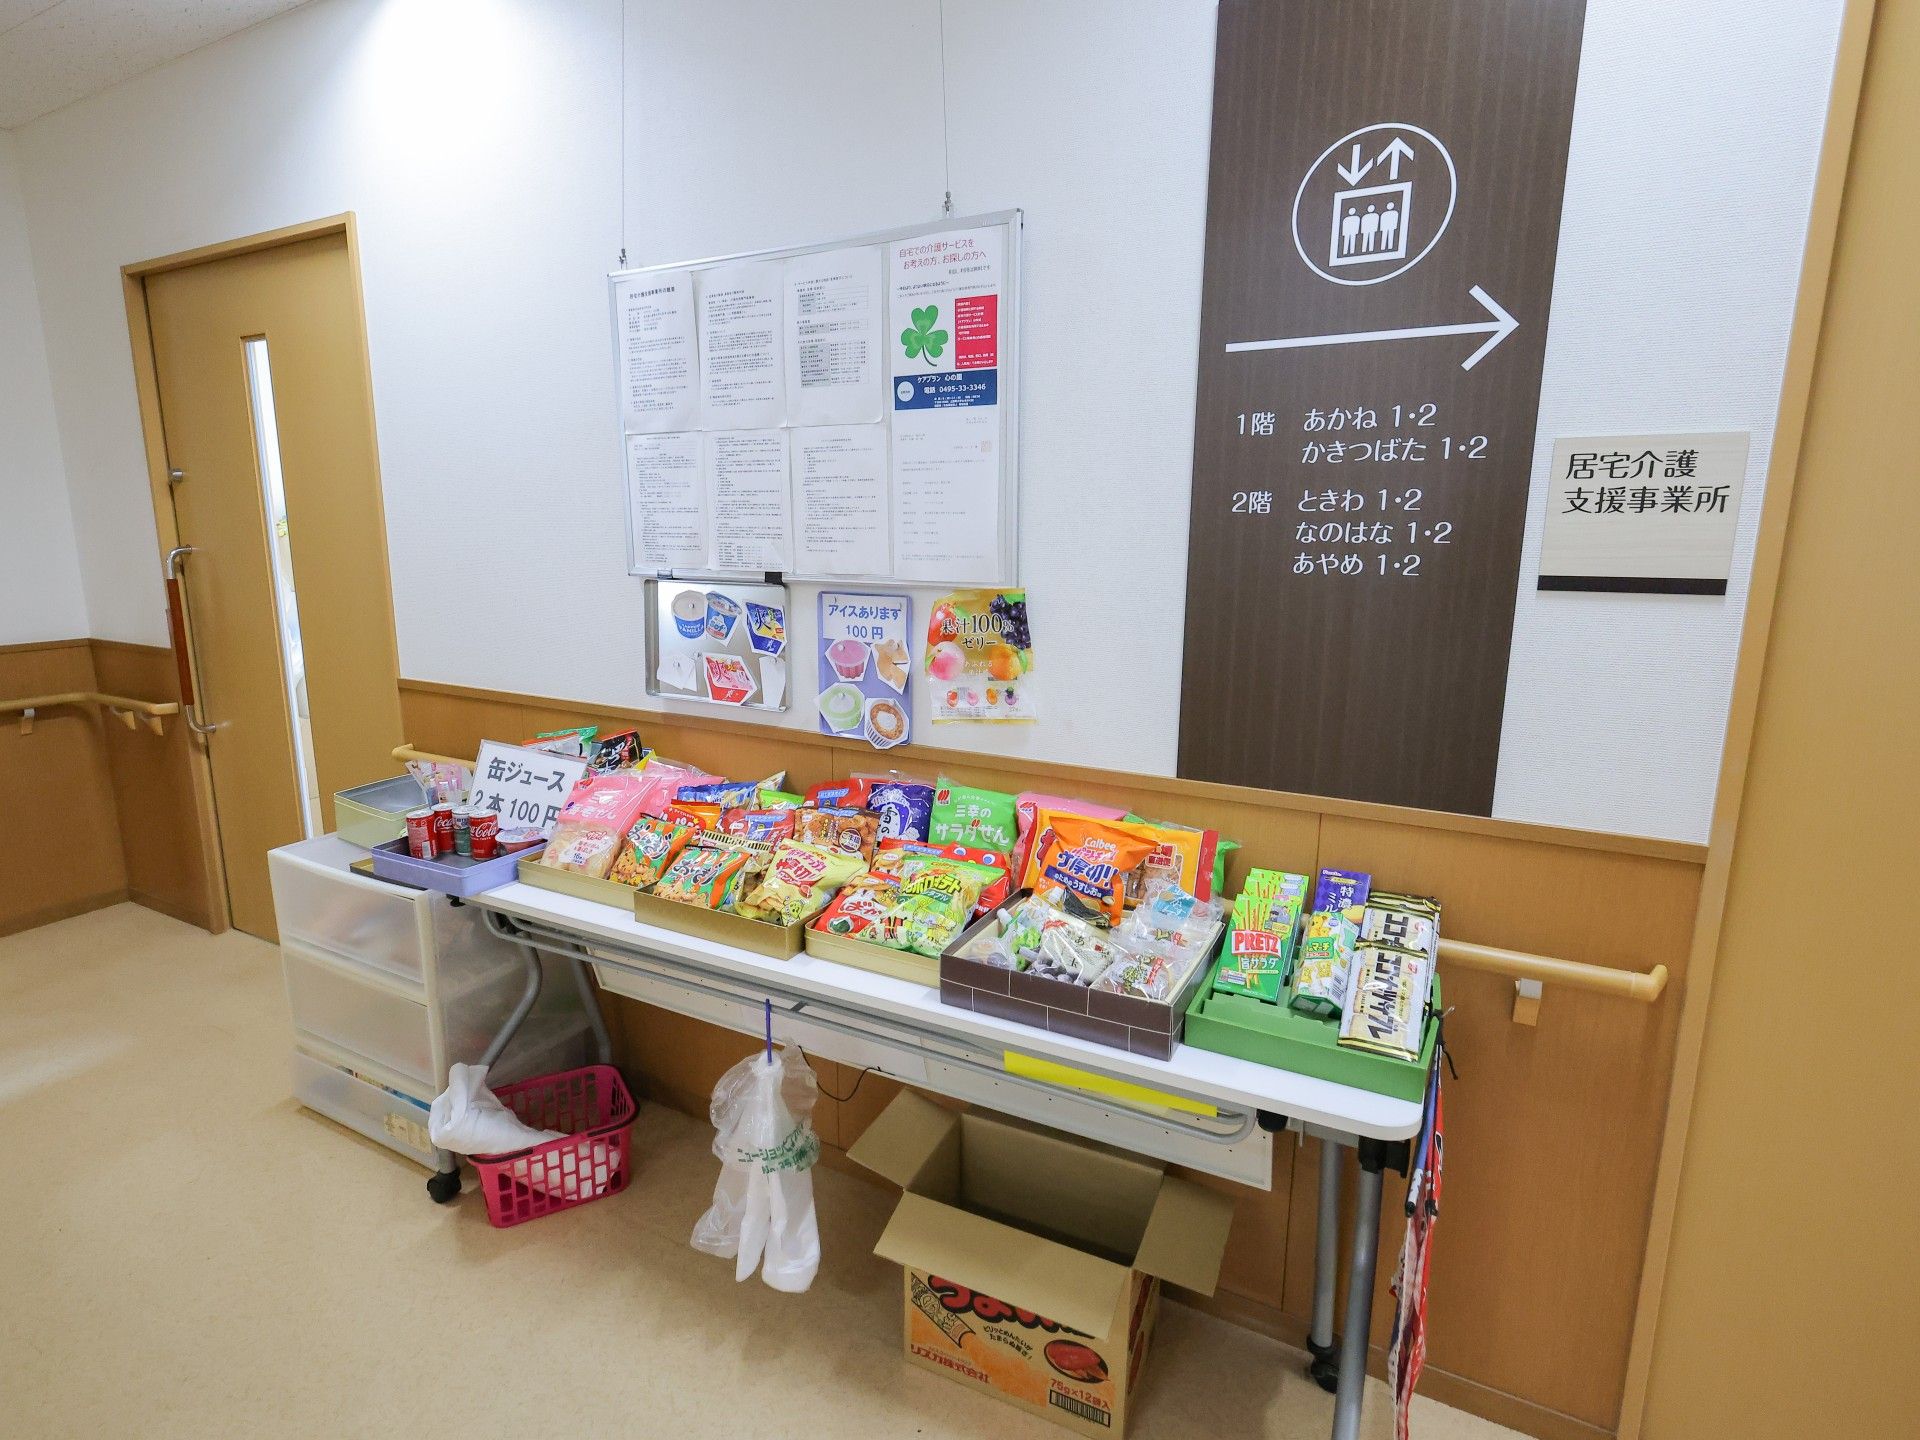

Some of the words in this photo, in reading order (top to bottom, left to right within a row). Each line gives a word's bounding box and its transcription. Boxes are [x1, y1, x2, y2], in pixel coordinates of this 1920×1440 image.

[899, 239, 975, 258] 自宅での介護サービスを
[903, 251, 986, 270] お考えの方、お探しの方へ
[917, 375, 941, 383] ケアプラン
[939, 383, 986, 393] 0495-33-3346
[1237, 411, 1276, 436] 1階
[1303, 406, 1377, 432] あかね
[1301, 438, 1427, 463] かきつばた
[1565, 449, 1700, 480] 居宅介護
[1231, 491, 1272, 514] 2階
[1297, 489, 1364, 512] ときわ
[1561, 485, 1731, 514] 支援事業所
[1295, 521, 1394, 544] なのはな
[1292, 552, 1363, 575] あやめ
[828, 604, 901, 620] アイスあります
[846, 625, 883, 639] 100円
[942, 613, 1015, 634] 果汁100%
[962, 637, 996, 649] ゼリー
[487, 757, 566, 793] 缶ジュース
[509, 800, 561, 828] 100円
[955, 804, 992, 818] 三幸の
[935, 823, 1010, 845] サラダせん
[1085, 837, 1116, 849] Calbee
[1323, 892, 1338, 912] ミル
[1234, 932, 1279, 953] PRETZ
[911, 1343, 990, 1384] リスカ株式会社
